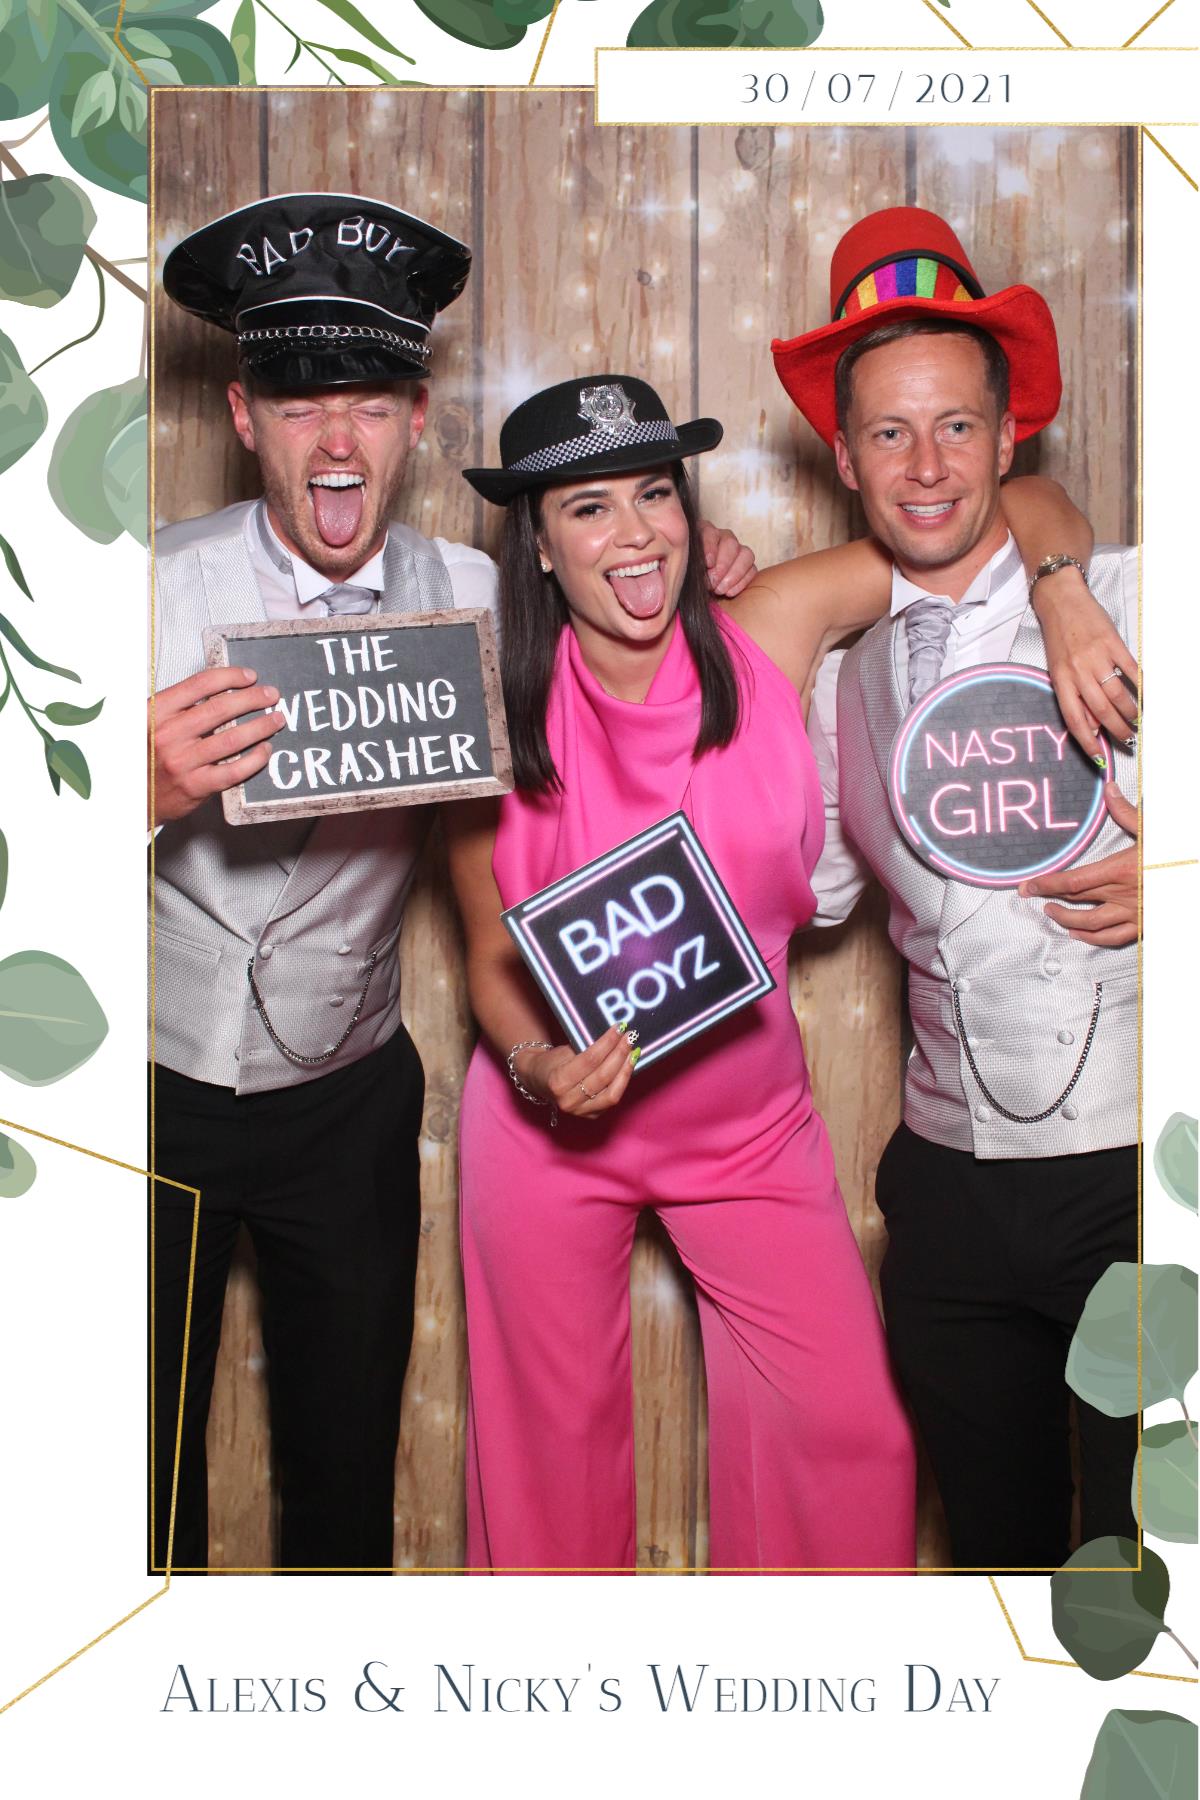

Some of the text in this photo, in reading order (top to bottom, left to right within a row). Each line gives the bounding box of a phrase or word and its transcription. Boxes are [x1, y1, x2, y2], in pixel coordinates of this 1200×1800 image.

[338, 215, 417, 263] BOY
[316, 635, 398, 676] THE
[265, 678, 457, 732] WEDDING
[268, 733, 482, 790] CRASHER
[924, 725, 1068, 769] NASTY
[929, 777, 1079, 836] GIRL
[558, 874, 685, 976] BAD
[596, 934, 721, 1028] BOYZ
